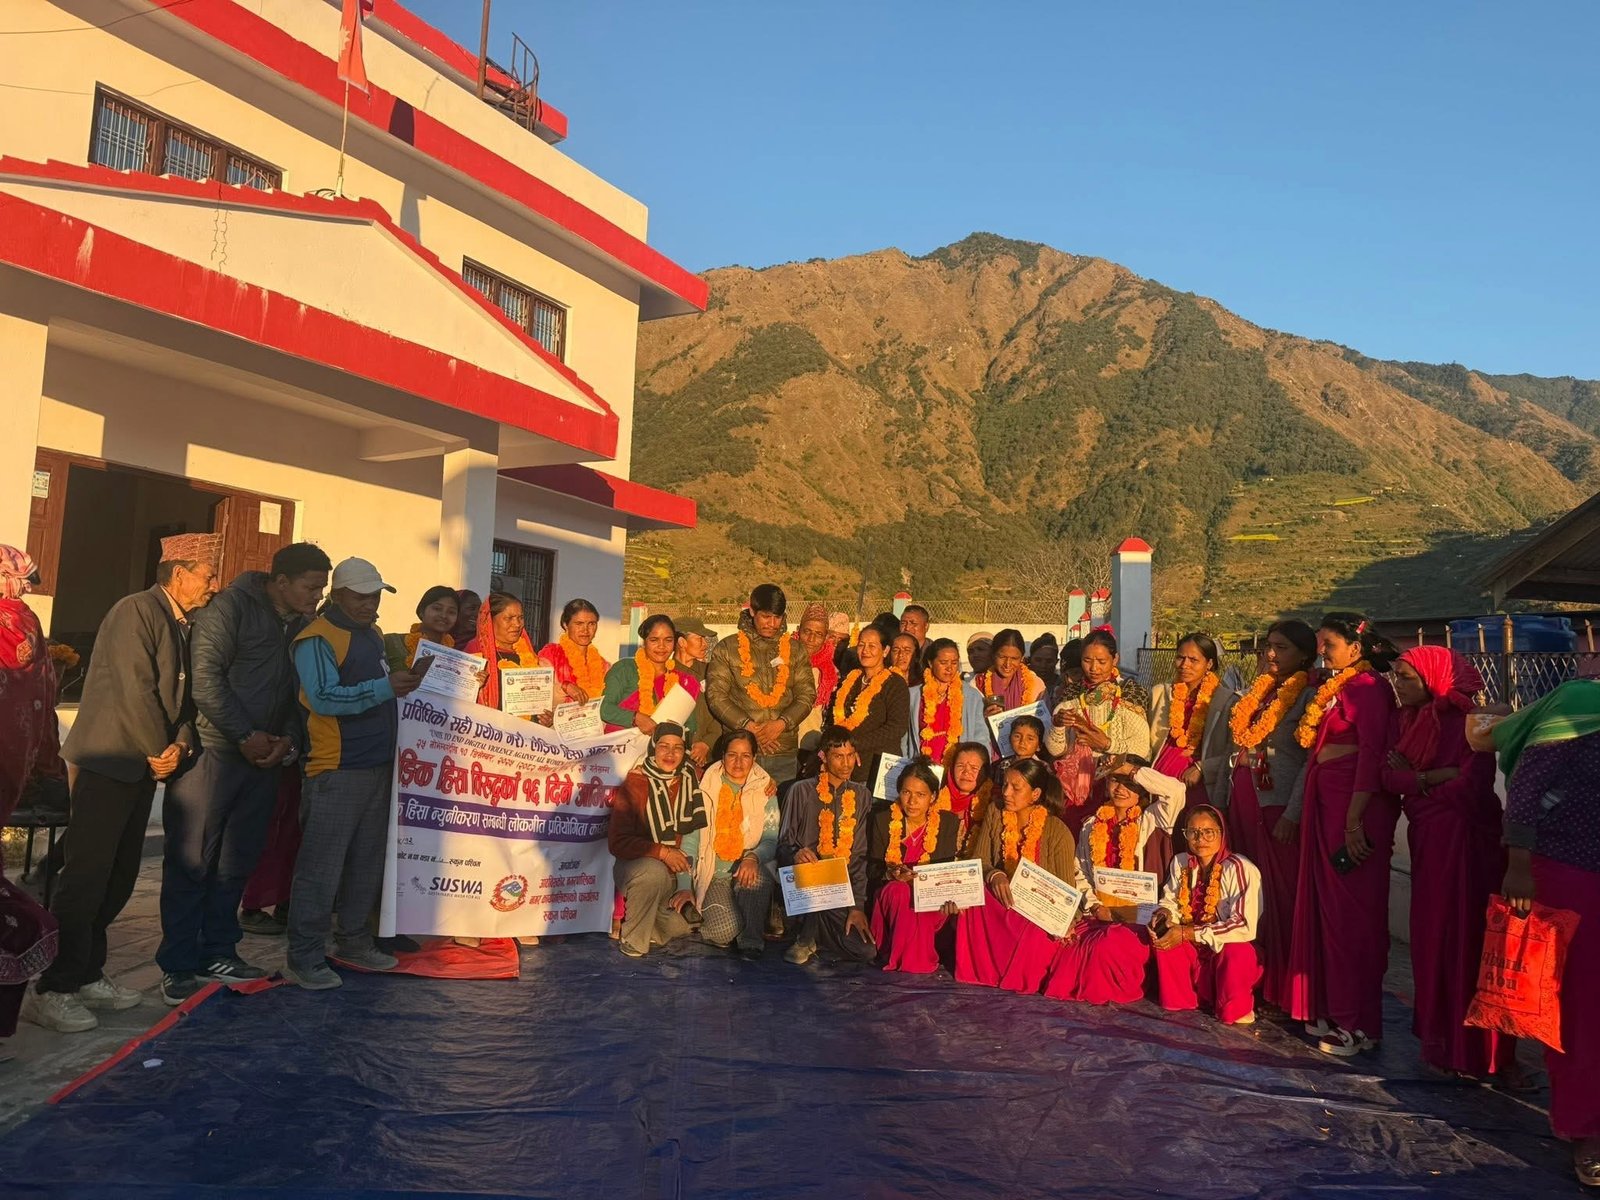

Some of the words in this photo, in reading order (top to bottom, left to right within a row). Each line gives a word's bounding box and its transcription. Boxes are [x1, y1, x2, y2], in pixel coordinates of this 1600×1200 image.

[401, 699, 449, 727] प्रविधिको
[450, 716, 473, 735] सही
[473, 723, 503, 742] प्रयोग
[452, 734, 465, 744] END
[465, 738, 486, 750] DIGITAL
[488, 743, 513, 756] VIOLENCE
[513, 750, 536, 761] AGAINST
[522, 778, 541, 807] १६
[544, 773, 574, 807] दिने
[405, 797, 431, 820] हिंसा
[508, 813, 547, 833] लोकगीत
[547, 816, 589, 837] प्रतियोगिता
[430, 877, 482, 895] SUSWA
